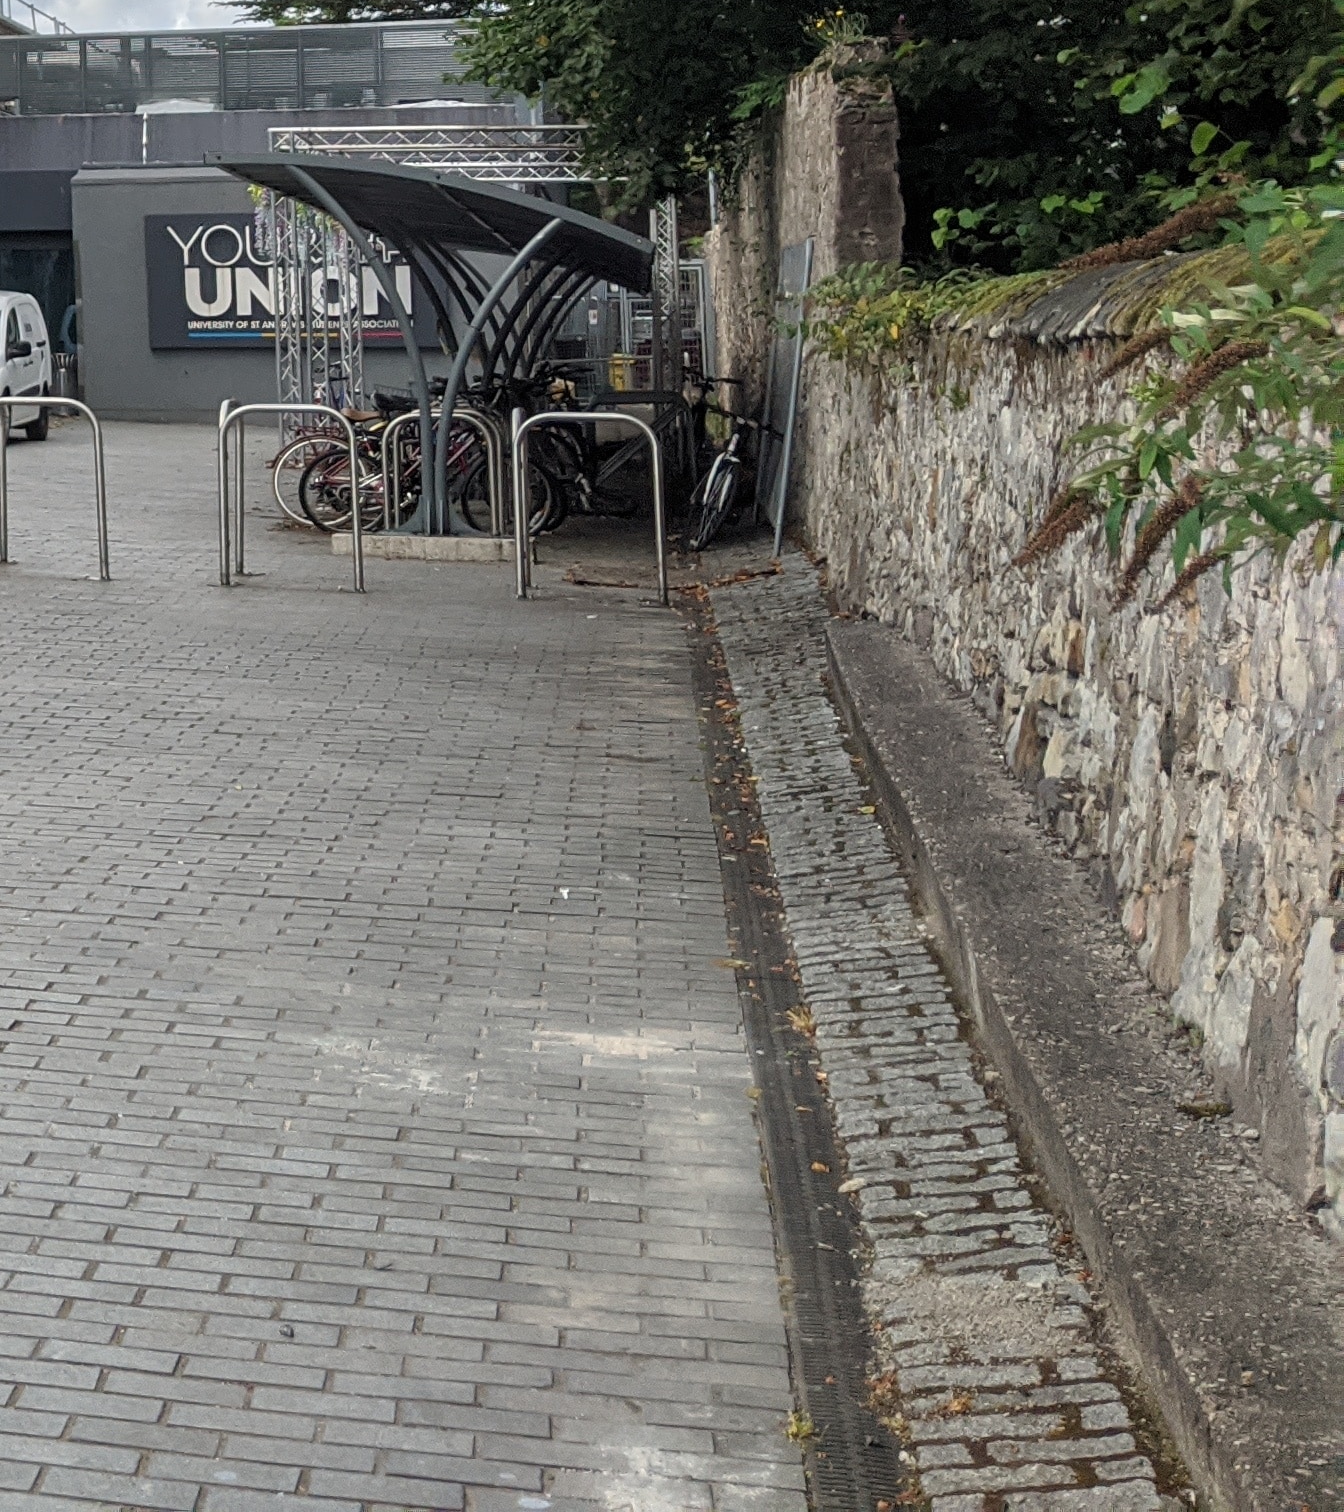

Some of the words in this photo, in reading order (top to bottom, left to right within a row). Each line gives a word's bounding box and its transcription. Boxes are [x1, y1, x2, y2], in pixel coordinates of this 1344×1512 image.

[184, 265, 412, 317] UNION
[187, 320, 234, 329] UNIVERSITY
[235, 320, 248, 329] OF
[250, 320, 260, 329] ST
